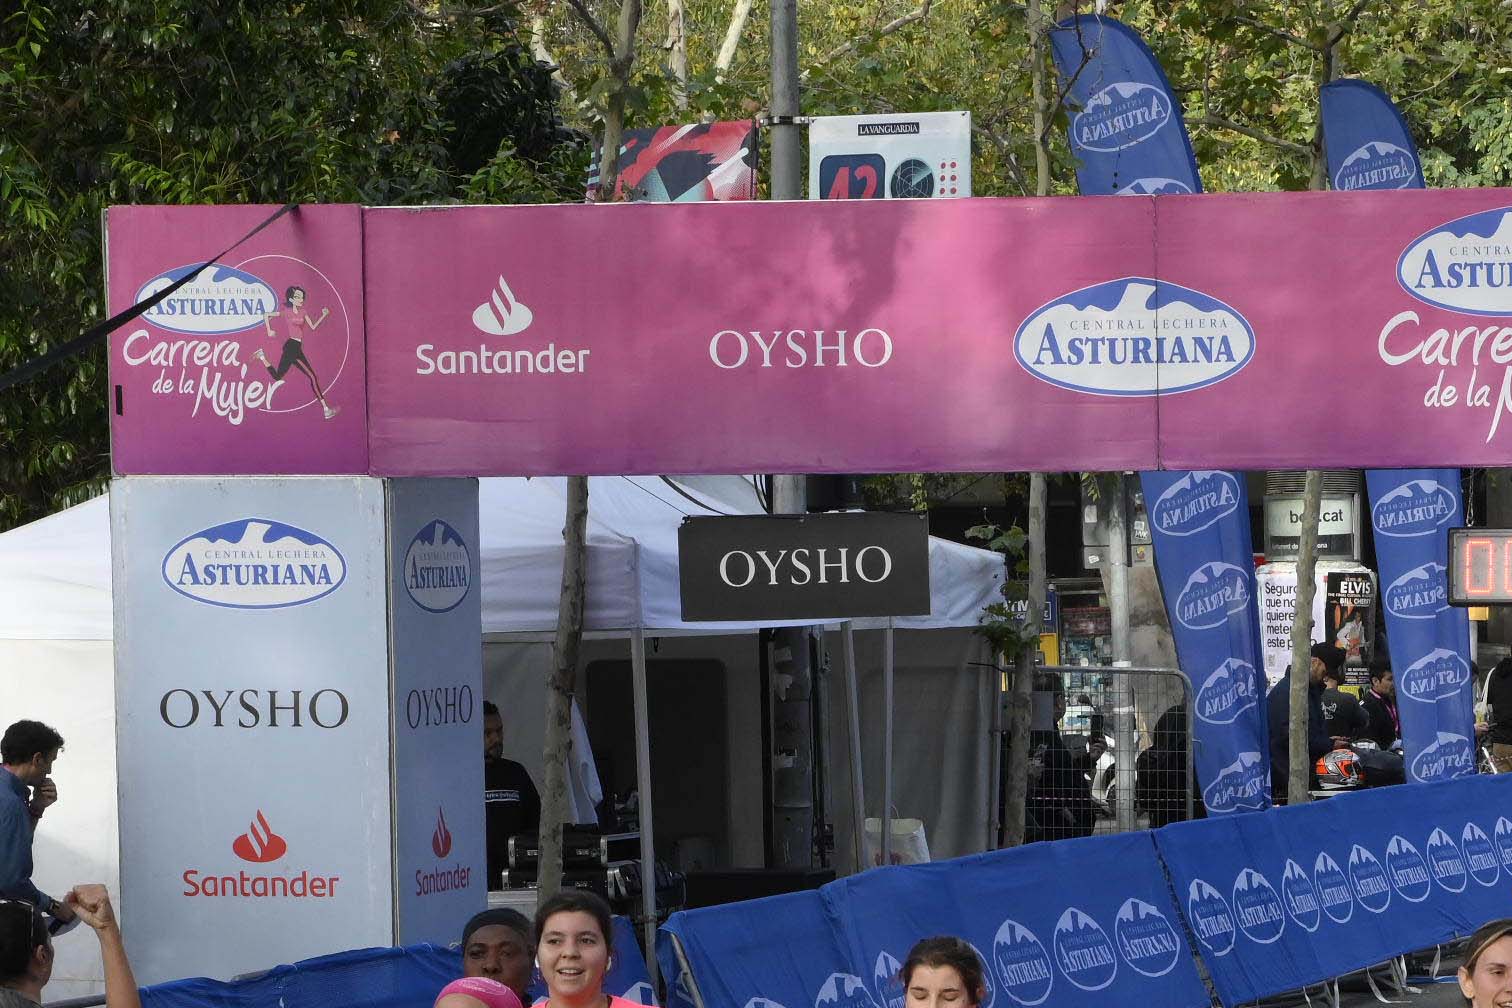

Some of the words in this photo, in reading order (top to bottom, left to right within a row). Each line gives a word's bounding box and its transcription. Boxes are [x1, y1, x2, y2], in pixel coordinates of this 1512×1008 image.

[1069, 317, 1150, 332] CENTRAL
[1153, 316, 1229, 331] LECHERA
[123, 329, 241, 366] Carrera
[416, 343, 591, 375] Santander
[708, 328, 894, 370] OYSHO
[1033, 322, 1237, 367] ASTURIANA
[152, 368, 174, 395] de
[179, 369, 195, 394] la
[191, 364, 285, 426] Mujer
[1423, 367, 1458, 408] de
[1465, 368, 1491, 408] la
[176, 552, 333, 587] ASTURIANA
[204, 549, 263, 560] CENTRAL
[268, 549, 327, 560] LECHERA
[719, 546, 892, 588] OYSHO
[409, 559, 468, 591] ASTURIANA
[1340, 581, 1371, 594] ELVIS
[1265, 599, 1281, 610] que
[1267, 638, 1286, 648] este
[159, 688, 350, 729] OYSHO
[406, 684, 473, 730] OYSHO
[183, 868, 340, 898] Santander
[416, 864, 472, 897] Santander
[1000, 955, 1049, 987] ASTURIANA
[1061, 941, 1114, 973] ASTURIANA
